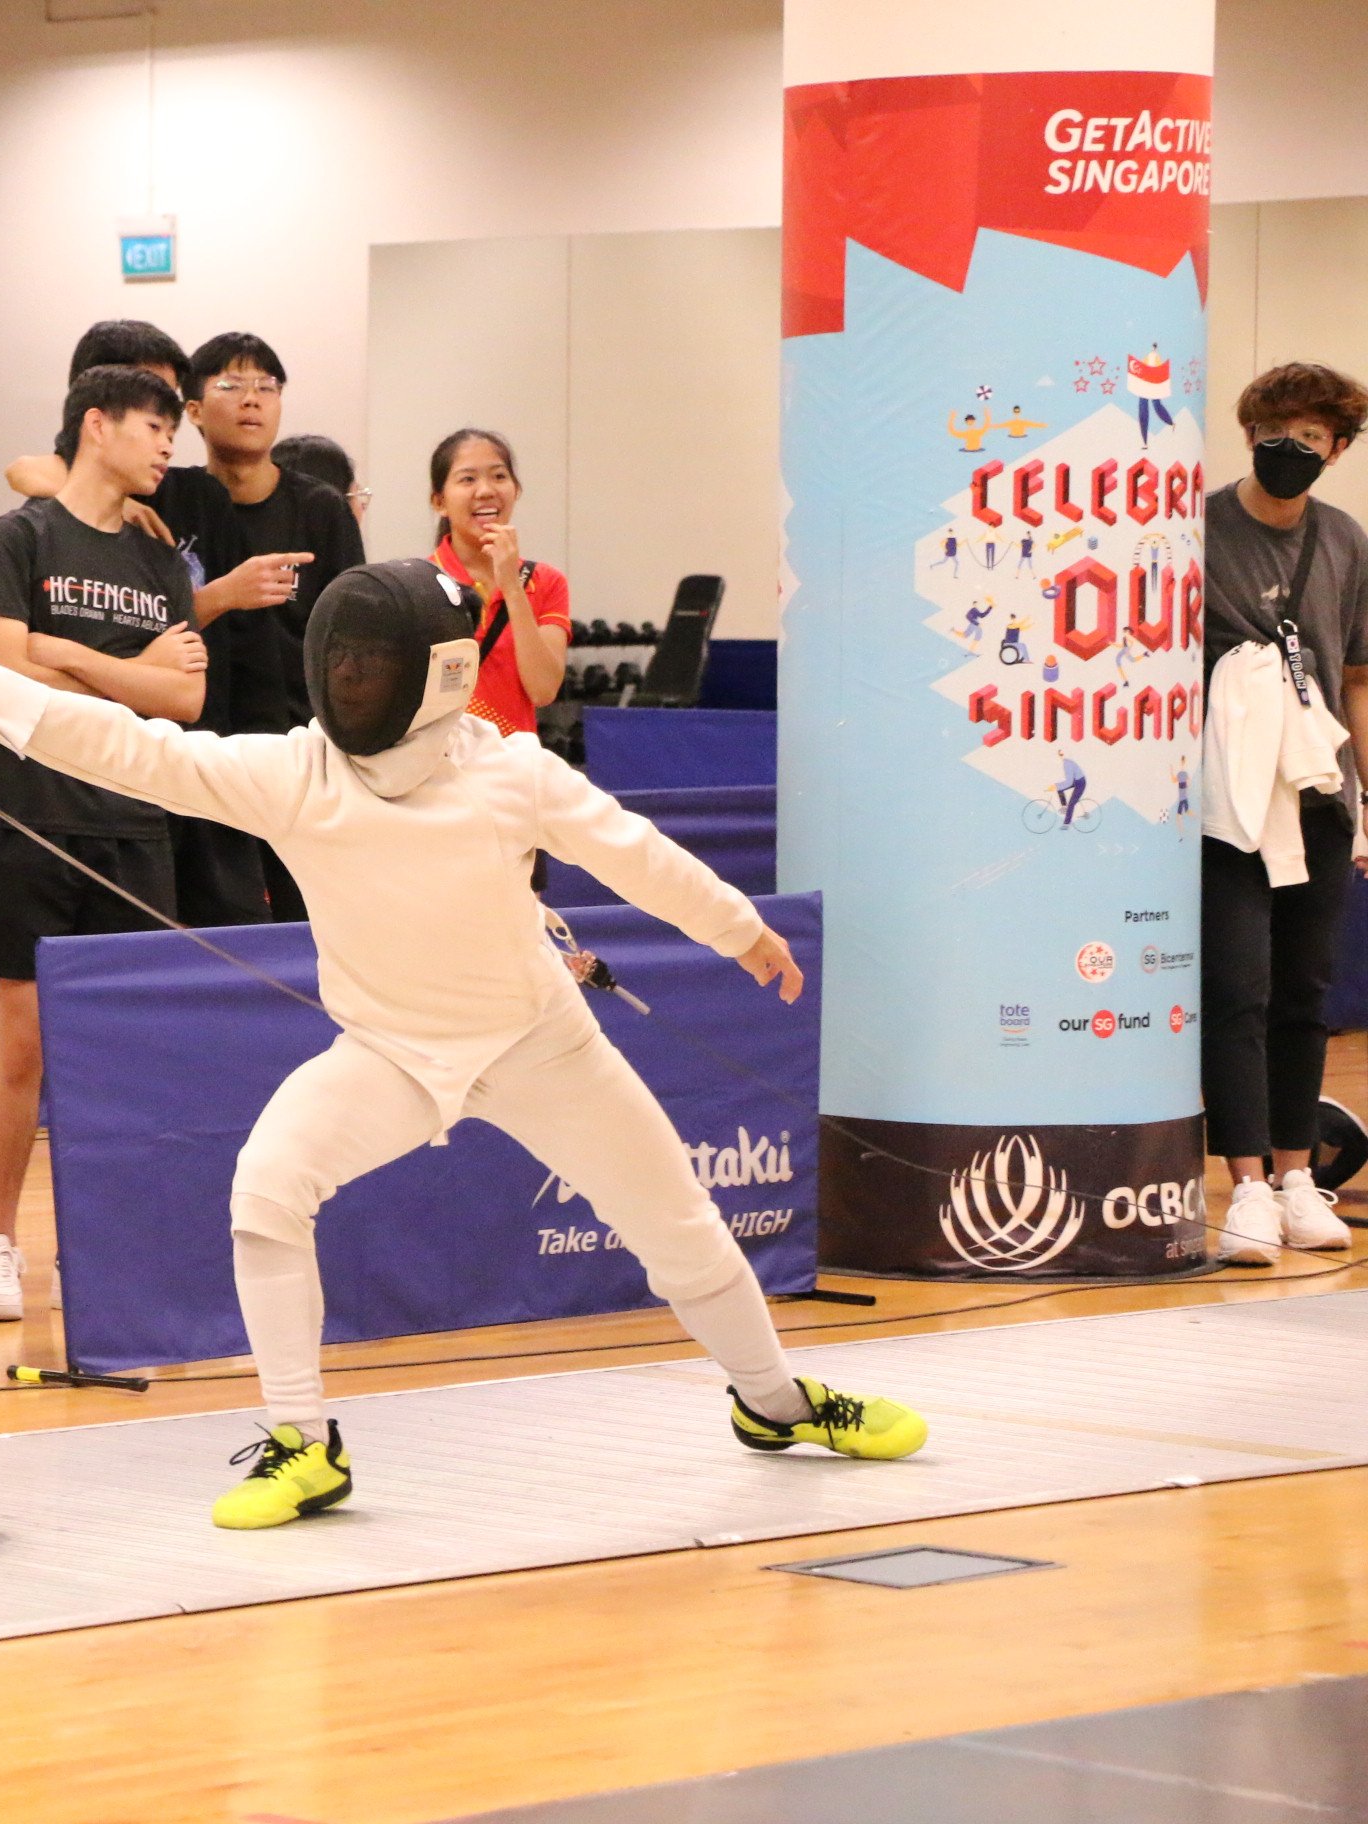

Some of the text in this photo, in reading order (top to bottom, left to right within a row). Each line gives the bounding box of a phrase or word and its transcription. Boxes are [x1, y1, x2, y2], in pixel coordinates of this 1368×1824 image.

[1044, 158, 1210, 195] SINGAPORE
[132, 243, 168, 269] EXIT
[49, 576, 167, 622] HC FENCING
[1053, 555, 1203, 660] OUR
[51, 605, 78, 616] BLADES
[112, 614, 141, 628] HEARTS
[1124, 909, 1170, 922] Partners
[1144, 954, 1156, 965] SG
[999, 1004, 1030, 1017] tote
[1059, 1012, 1150, 1031] our SG fund
[1171, 1012, 1183, 1026] SG
[732, 1209, 793, 1238] HIGH
[537, 1227, 599, 1255] Take
